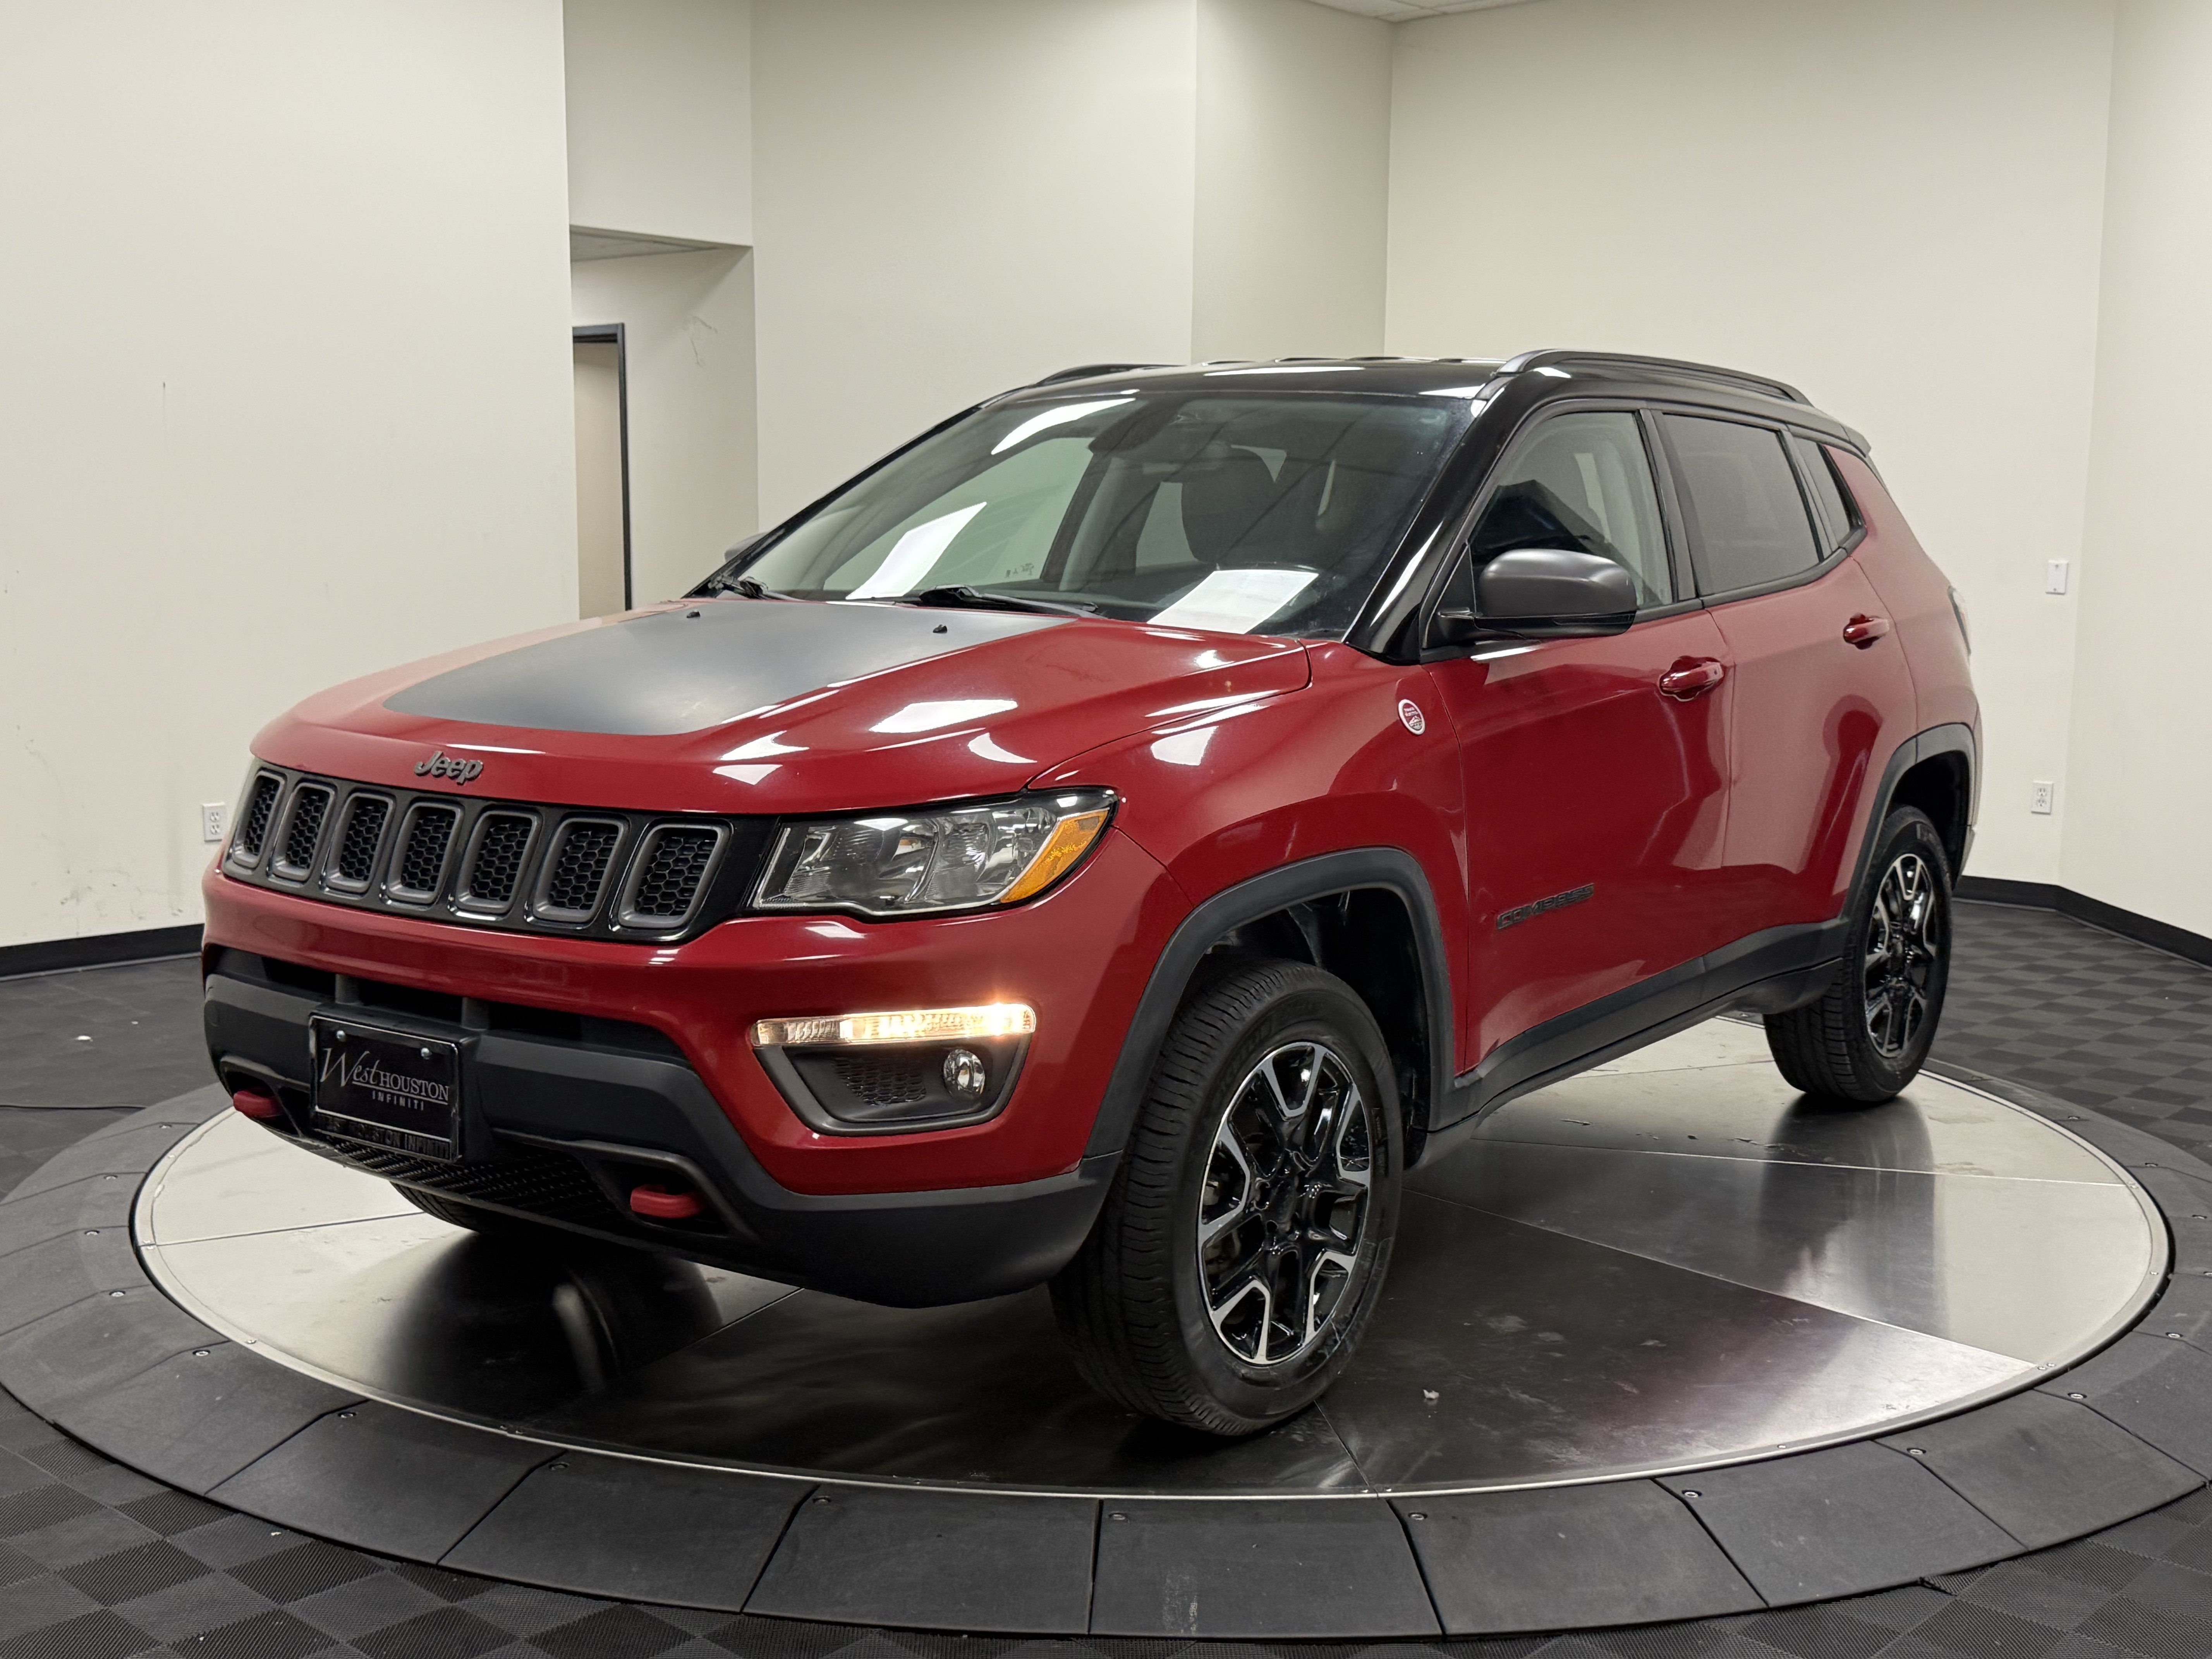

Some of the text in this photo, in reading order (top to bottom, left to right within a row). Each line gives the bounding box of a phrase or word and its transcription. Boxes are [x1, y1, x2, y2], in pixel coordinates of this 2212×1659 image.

[414, 750, 483, 785] Jeep
[1497, 883, 1594, 929] COMPASS
[372, 1090, 424, 1111] INFINITI
[380, 1071, 450, 1101] HOUSTON
